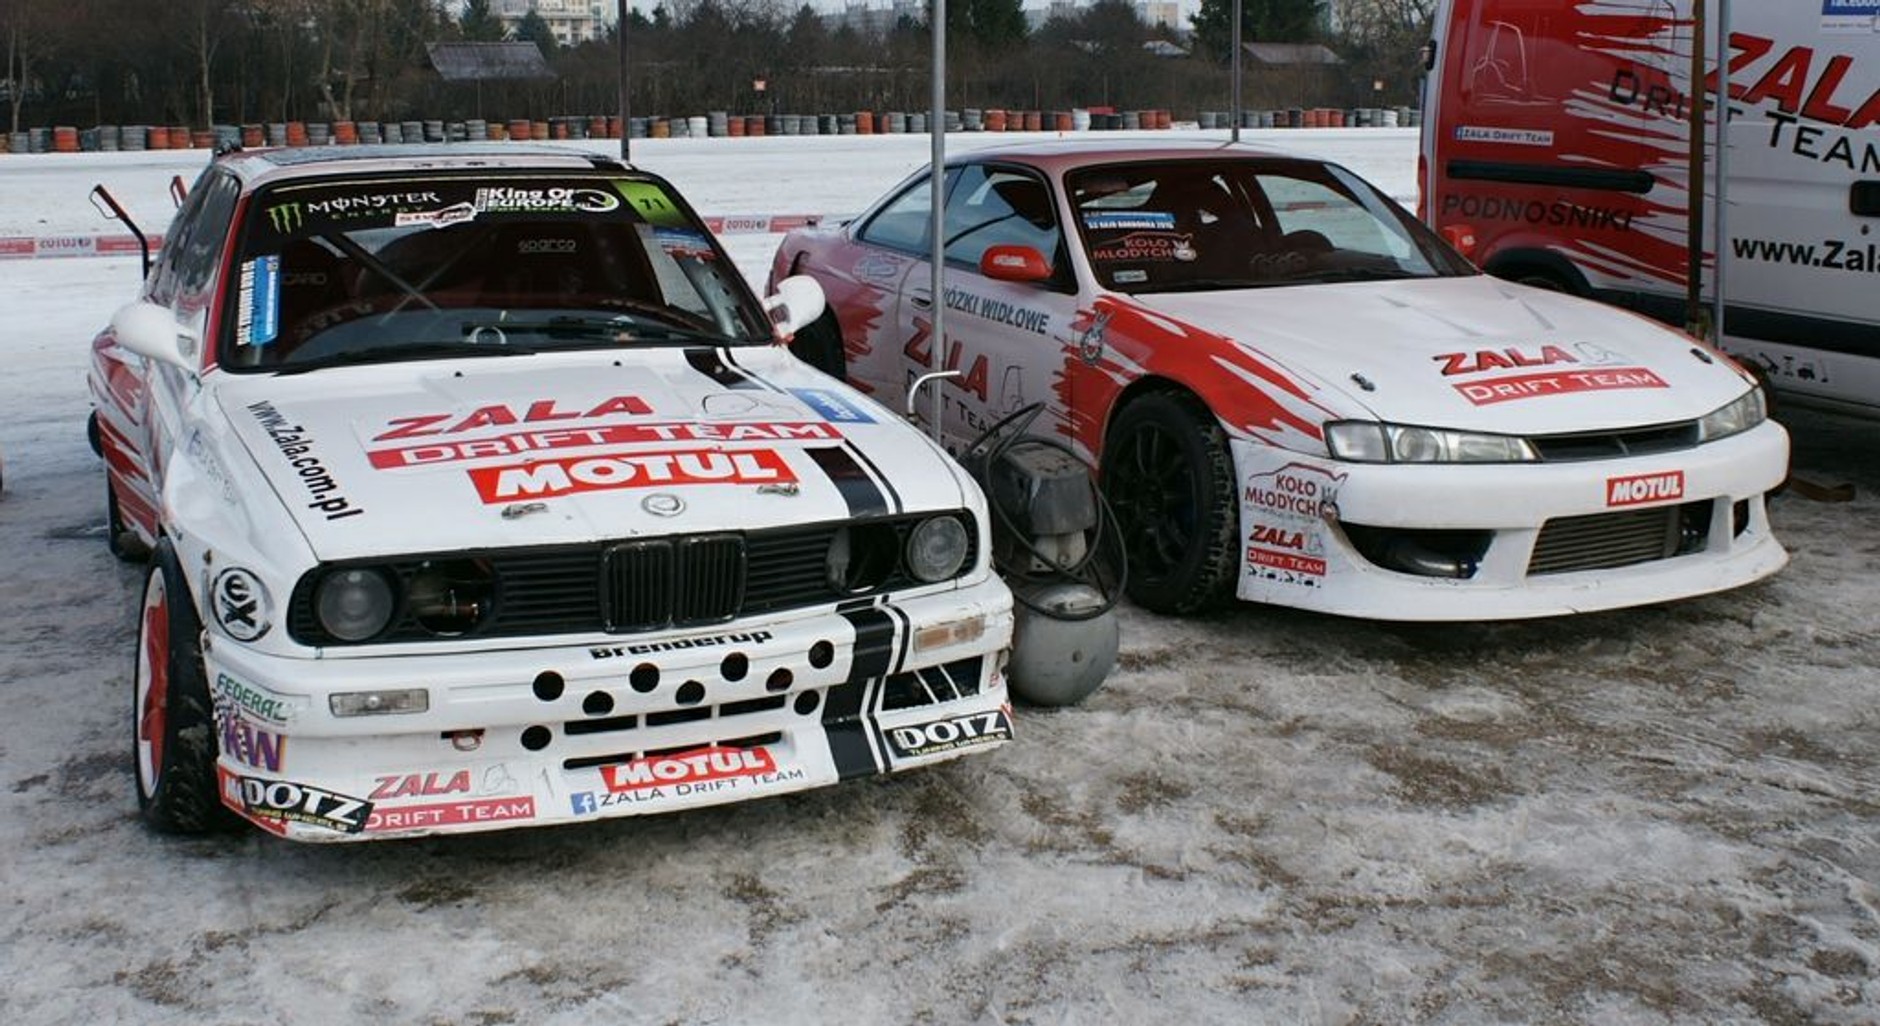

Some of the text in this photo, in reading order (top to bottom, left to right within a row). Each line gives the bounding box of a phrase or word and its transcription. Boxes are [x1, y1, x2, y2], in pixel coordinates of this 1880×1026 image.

[638, 198, 666, 211] 71
[1732, 237, 1880, 273] www.Zal
[981, 297, 1050, 335] WIDŁOWE
[903, 316, 988, 403] ZLA
[1432, 344, 1581, 377] ZALA
[1463, 373, 1660, 401] DRIFT TEAM
[372, 395, 654, 442] ZALA
[246, 400, 365, 521] www.Zala.com.pl
[401, 421, 829, 464] DRIFT TEAM
[495, 451, 779, 497] MOTUL
[1275, 474, 1317, 497] KOŁO
[1610, 475, 1681, 504] MOTUL
[1244, 487, 1318, 517] MŁODYCH
[1248, 525, 1304, 550] ZALA
[1248, 550, 1325, 573] DRIFT TEAM
[588, 630, 774, 660] Brenderup
[216, 672, 288, 721] FEDERAL
[892, 712, 1007, 750] DOTZ
[367, 770, 470, 800] ZALA
[614, 751, 765, 787] MOTUL
[243, 779, 367, 826] DOTZ
[601, 786, 666, 807] ZALA
[676, 778, 738, 797] DRIFT
[748, 768, 804, 786] TEAM
[364, 803, 531, 829] DRIFT TEAM
